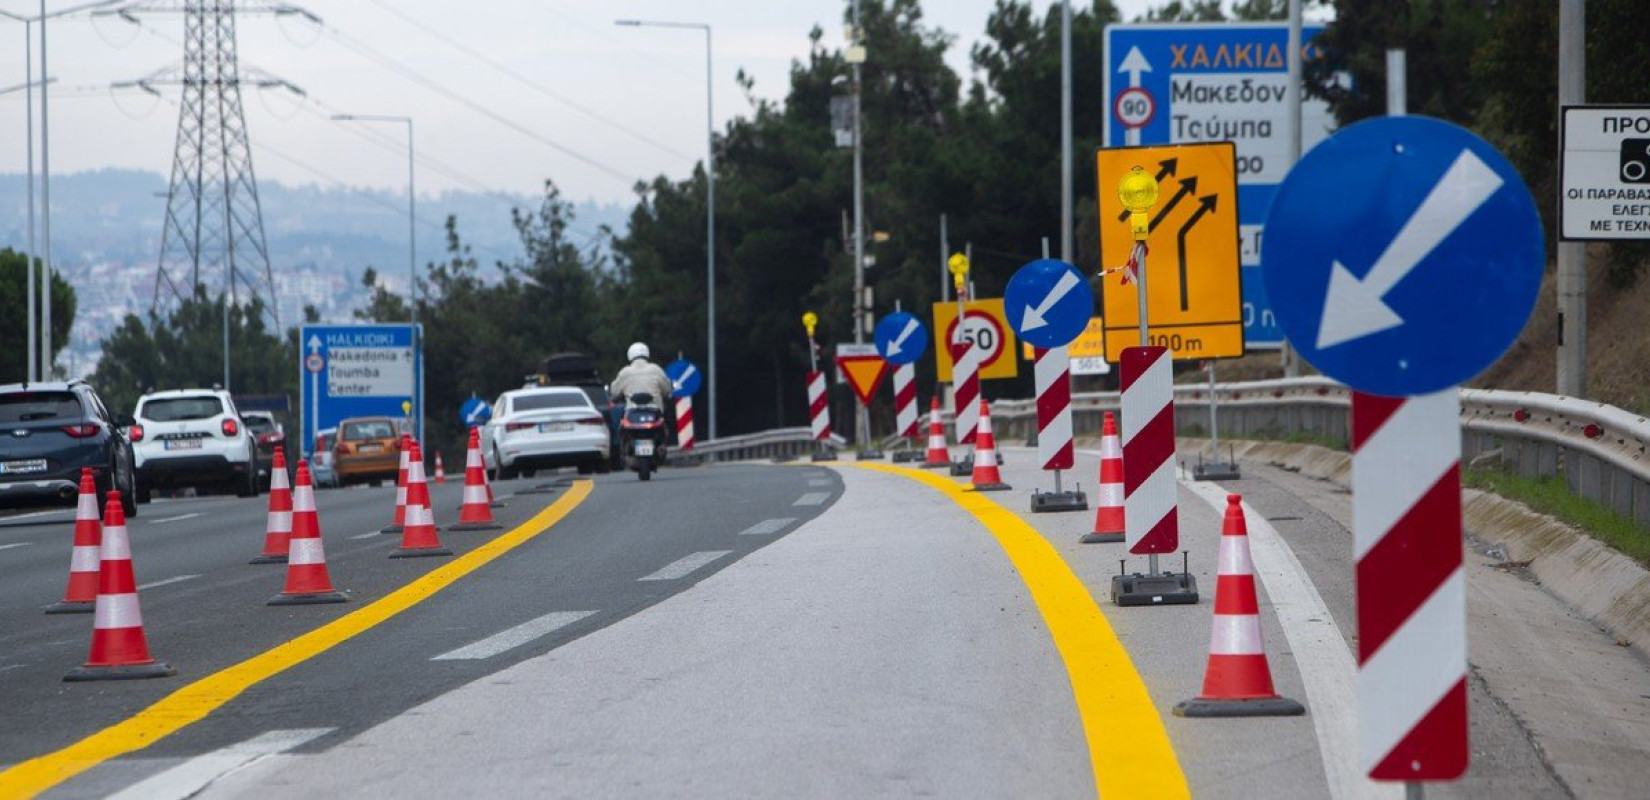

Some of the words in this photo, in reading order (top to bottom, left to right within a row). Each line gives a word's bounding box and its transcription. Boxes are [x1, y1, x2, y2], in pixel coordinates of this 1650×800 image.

[1171, 79, 1308, 103] Μακεδον
[1123, 99, 1148, 117] 90
[1568, 189, 1583, 200] ΟΙ
[1590, 220, 1611, 231] ΜΕ
[326, 334, 395, 346] HALKIDIKI
[961, 327, 993, 350] 50
[1149, 334, 1182, 352] 100
[1186, 338, 1203, 351] m
[328, 350, 397, 361] Makedonia
[329, 366, 380, 378] Toumba
[329, 383, 372, 394] Center
